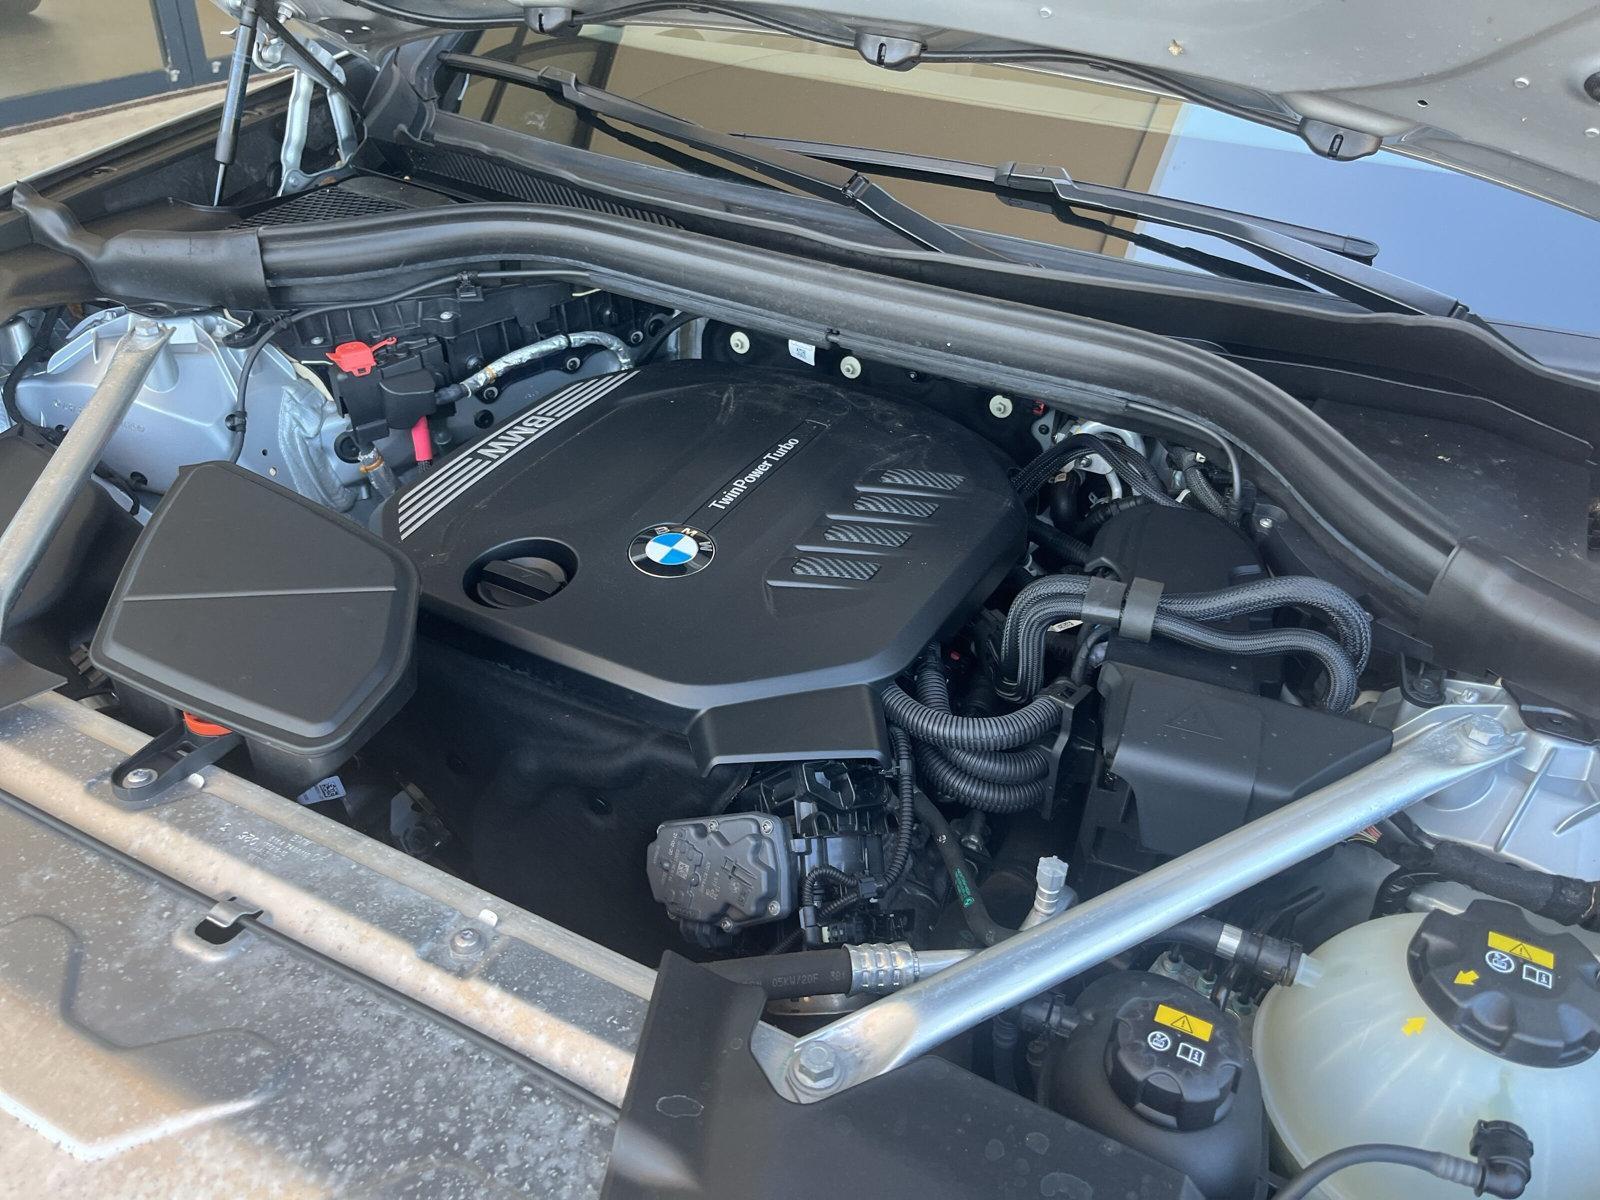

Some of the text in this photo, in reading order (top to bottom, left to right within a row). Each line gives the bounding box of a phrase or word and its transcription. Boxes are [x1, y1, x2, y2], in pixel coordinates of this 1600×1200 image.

[477, 415, 556, 460] BMW
[708, 438, 800, 510] TwinPower Turbo
